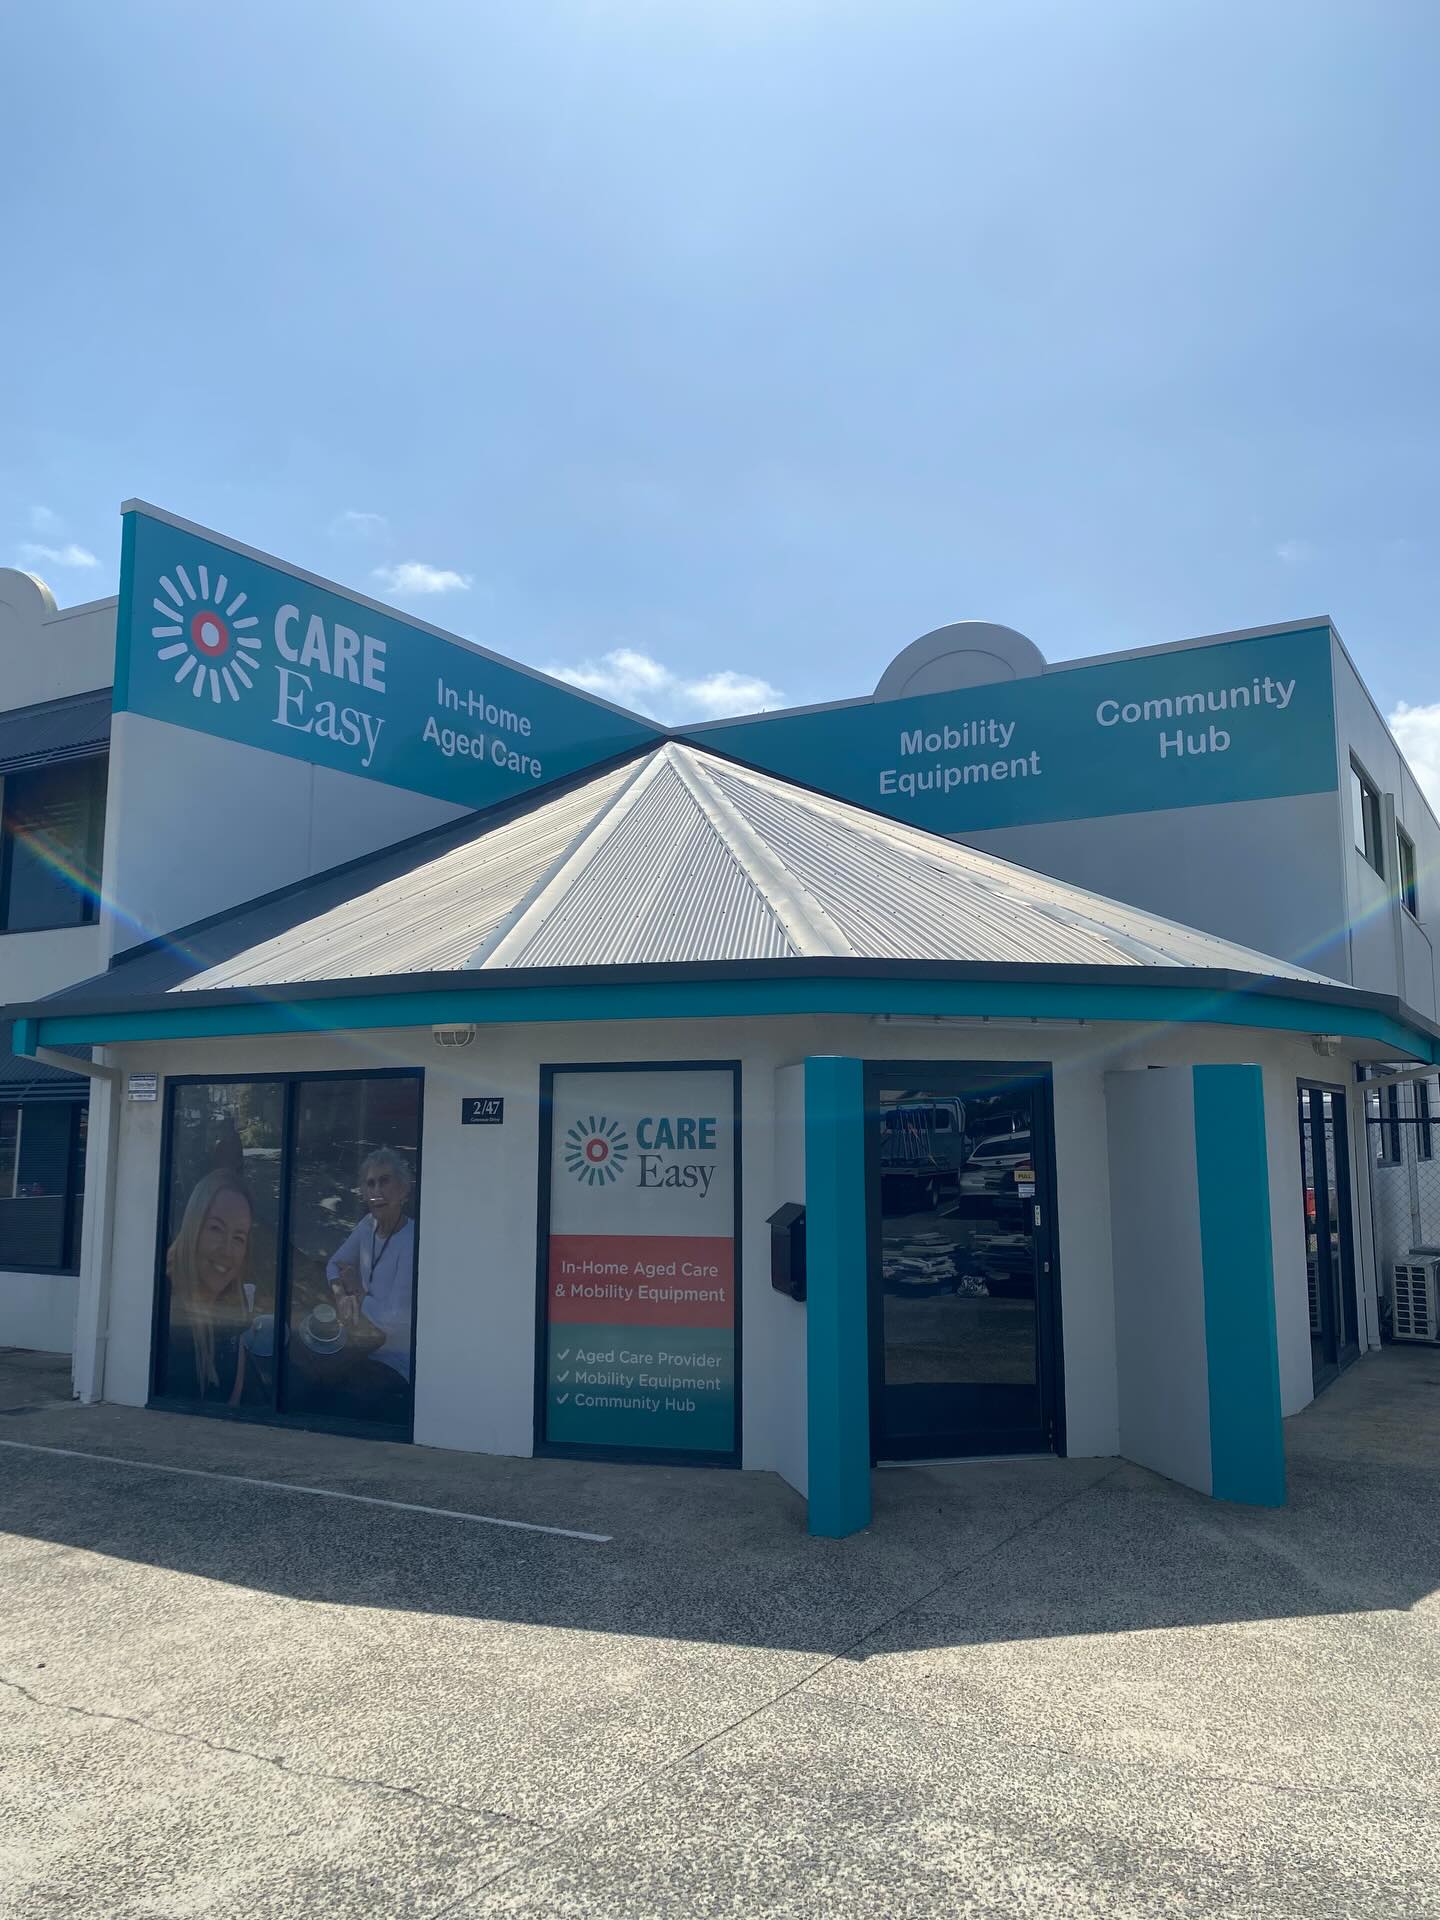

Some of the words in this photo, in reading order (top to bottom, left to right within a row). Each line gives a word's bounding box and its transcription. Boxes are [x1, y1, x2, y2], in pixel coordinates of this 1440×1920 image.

[274, 604, 387, 694] CARE
[272, 665, 385, 767] Easy
[437, 677, 532, 737] In-Home
[1096, 676, 1296, 727] Community
[423, 716, 484, 760] Aged
[491, 739, 542, 779] Care
[900, 718, 1016, 756] Mobility
[1159, 725, 1232, 759] Hub
[879, 750, 1042, 797] Equipment
[472, 1100, 500, 1115] 2/47
[636, 1117, 717, 1150] CARE
[636, 1154, 718, 1198] Easy
[562, 1260, 629, 1275] In-Home
[634, 1262, 676, 1278] Aged
[681, 1263, 719, 1277] Care
[555, 1283, 566, 1297] &
[571, 1284, 633, 1301] Mobility
[638, 1285, 726, 1304] Equipment
[575, 1349, 615, 1364] Aged
[619, 1350, 653, 1365] Care
[658, 1352, 722, 1368] Provider
[575, 1371, 633, 1388] Mobility
[639, 1374, 721, 1391] Equipment
[575, 1393, 660, 1412] Community
[665, 1397, 696, 1412] Hub
